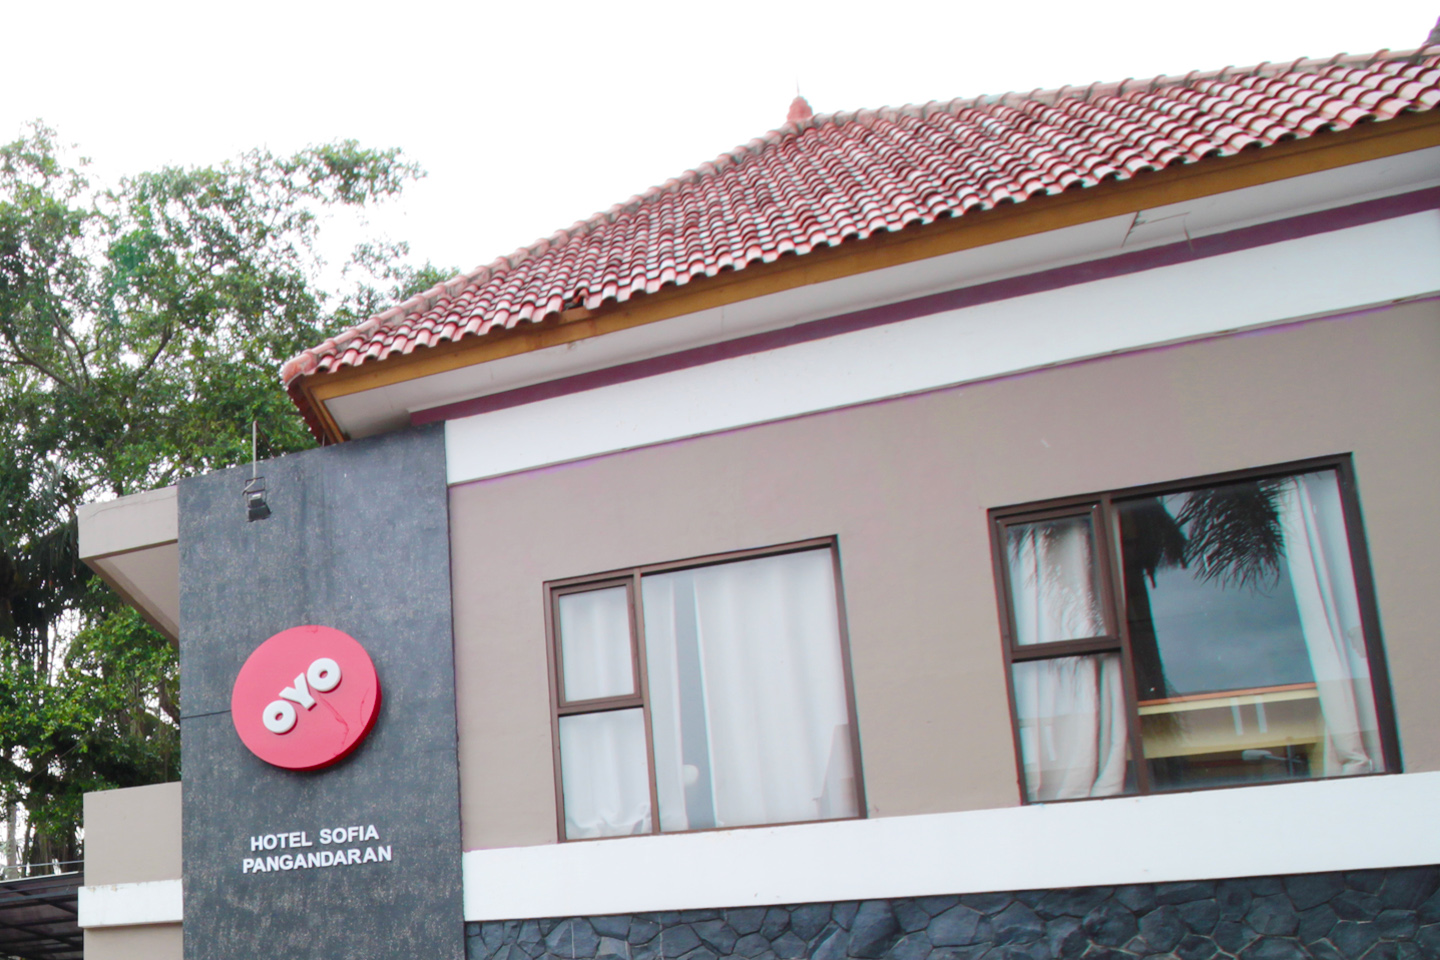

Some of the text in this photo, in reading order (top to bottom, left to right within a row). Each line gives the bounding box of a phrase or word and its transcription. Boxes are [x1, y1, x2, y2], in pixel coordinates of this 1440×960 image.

[262, 657, 342, 734] OYO
[250, 824, 379, 851] HOTEL SOFIA
[242, 845, 392, 873] PANGANDARAN
